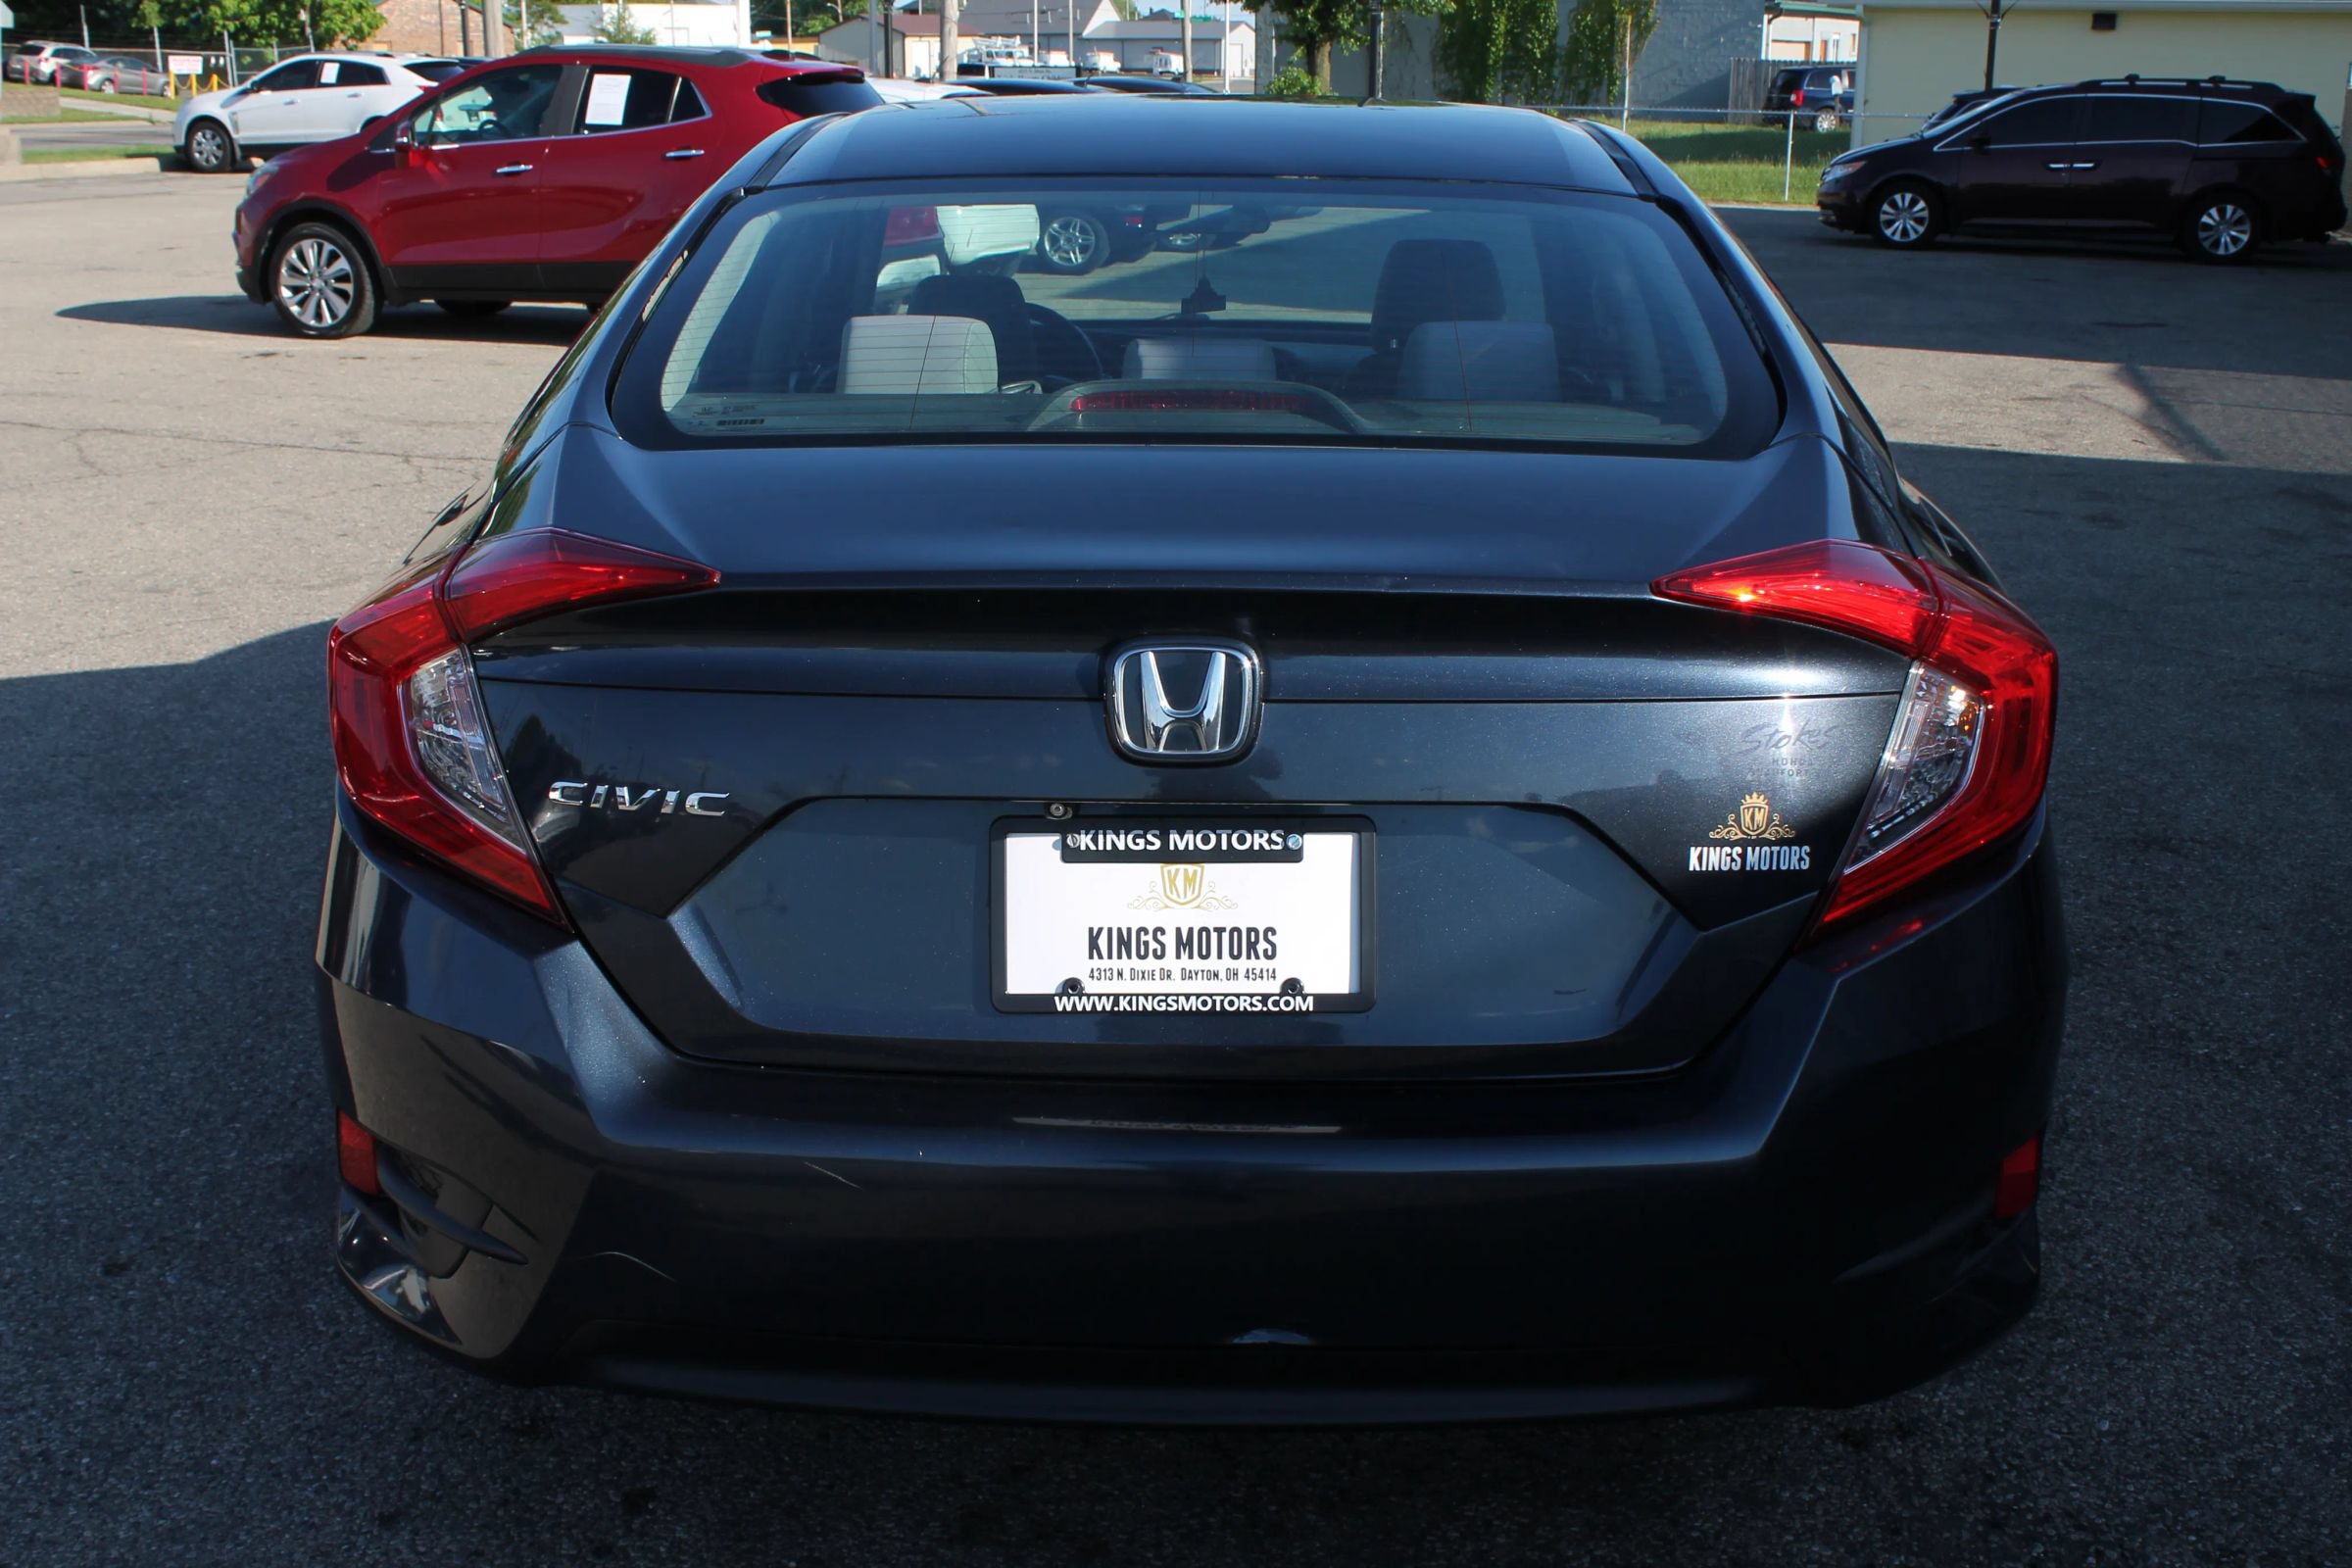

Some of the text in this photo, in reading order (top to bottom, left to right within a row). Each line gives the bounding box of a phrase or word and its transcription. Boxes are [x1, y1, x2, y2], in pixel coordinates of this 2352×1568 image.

[548, 780, 730, 817] CIVIC
[1079, 829, 1285, 852] KINGS MOTORS
[1689, 846, 1810, 871] KINGS MOTORS
[1167, 866, 1199, 899] KM
[1088, 926, 1277, 960] KINGS MOTORS
[1088, 967, 1113, 981] 4313
[1117, 967, 1127, 981] N.
[1226, 967, 1239, 981] OH
[1244, 967, 1277, 981] 45414
[1054, 995, 1314, 1012] WWW.KINGSMOTORS.COM
